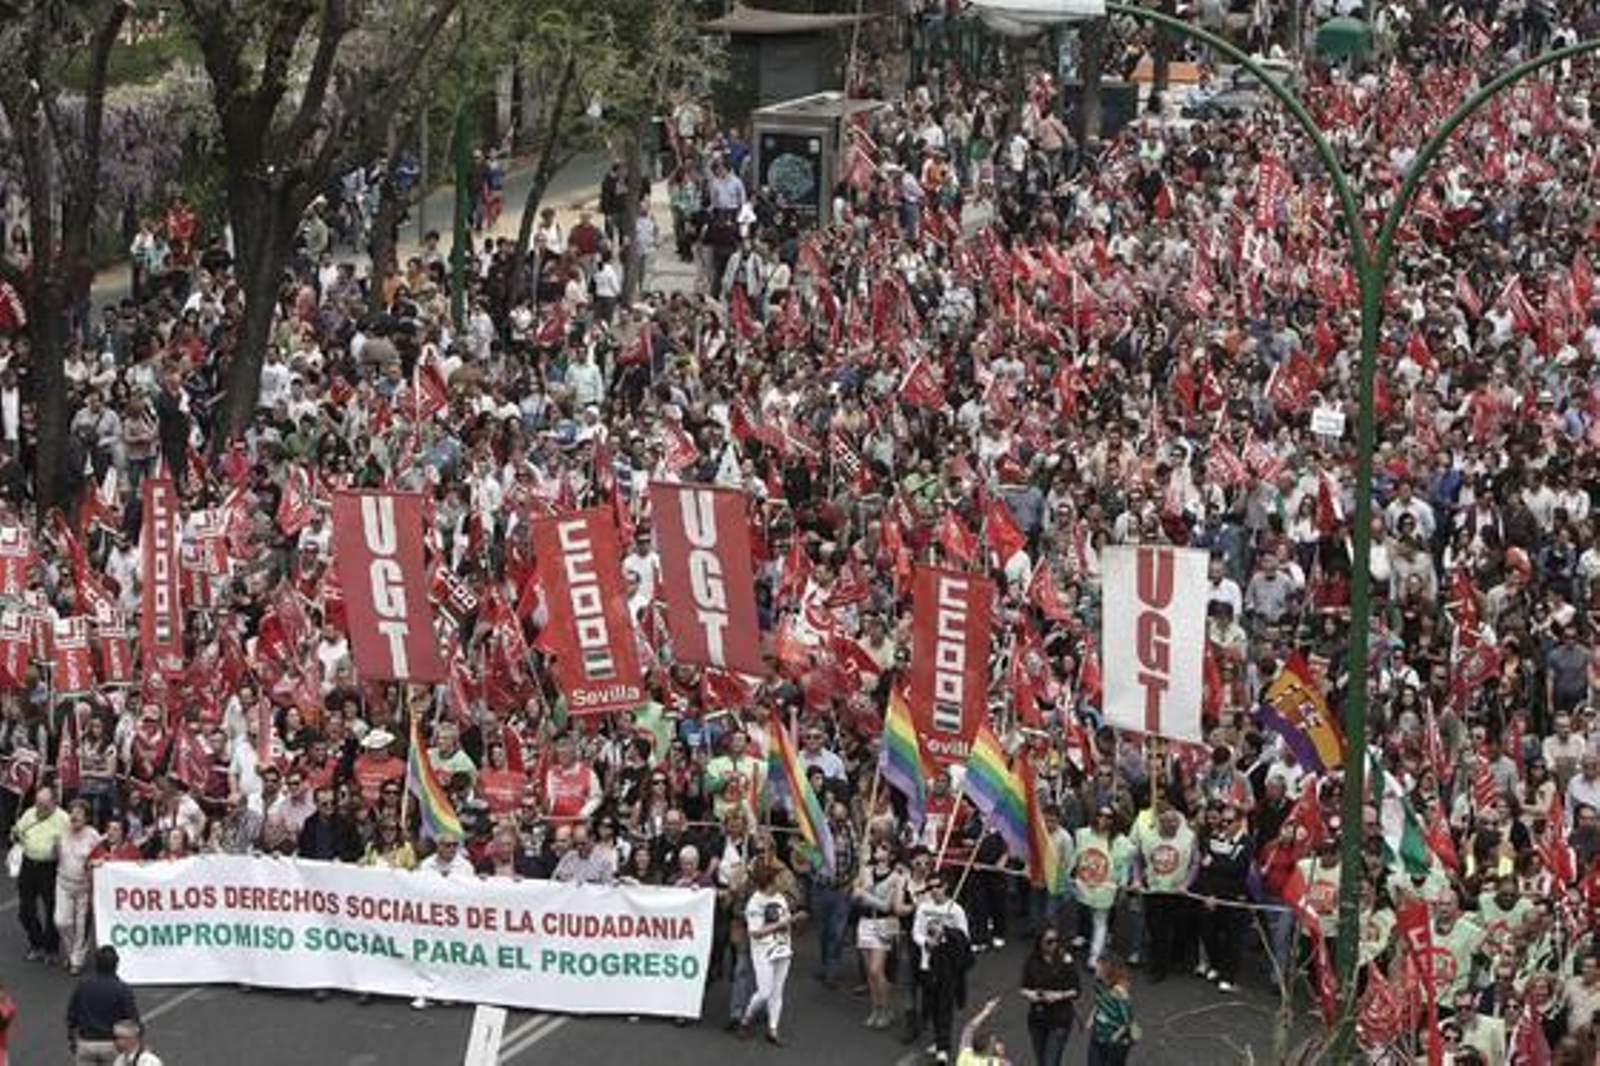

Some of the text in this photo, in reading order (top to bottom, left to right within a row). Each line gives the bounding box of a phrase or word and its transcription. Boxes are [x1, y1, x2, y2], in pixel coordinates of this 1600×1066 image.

[361, 496, 409, 679] UGT
[435, 567, 477, 609] CCOO
[558, 519, 609, 651] CCOO
[679, 490, 730, 666] UGT
[935, 576, 968, 709] CCOO
[1136, 548, 1174, 735] UGT
[572, 684, 640, 707] Sevilla
[920, 733, 974, 757] evill
[110, 923, 700, 980] COMPROMISO SOCIAL PARA EL PROGRESO
[115, 886, 694, 940] POR LOS DERECHOS SOCIALES DE LA CIUDADANIA
